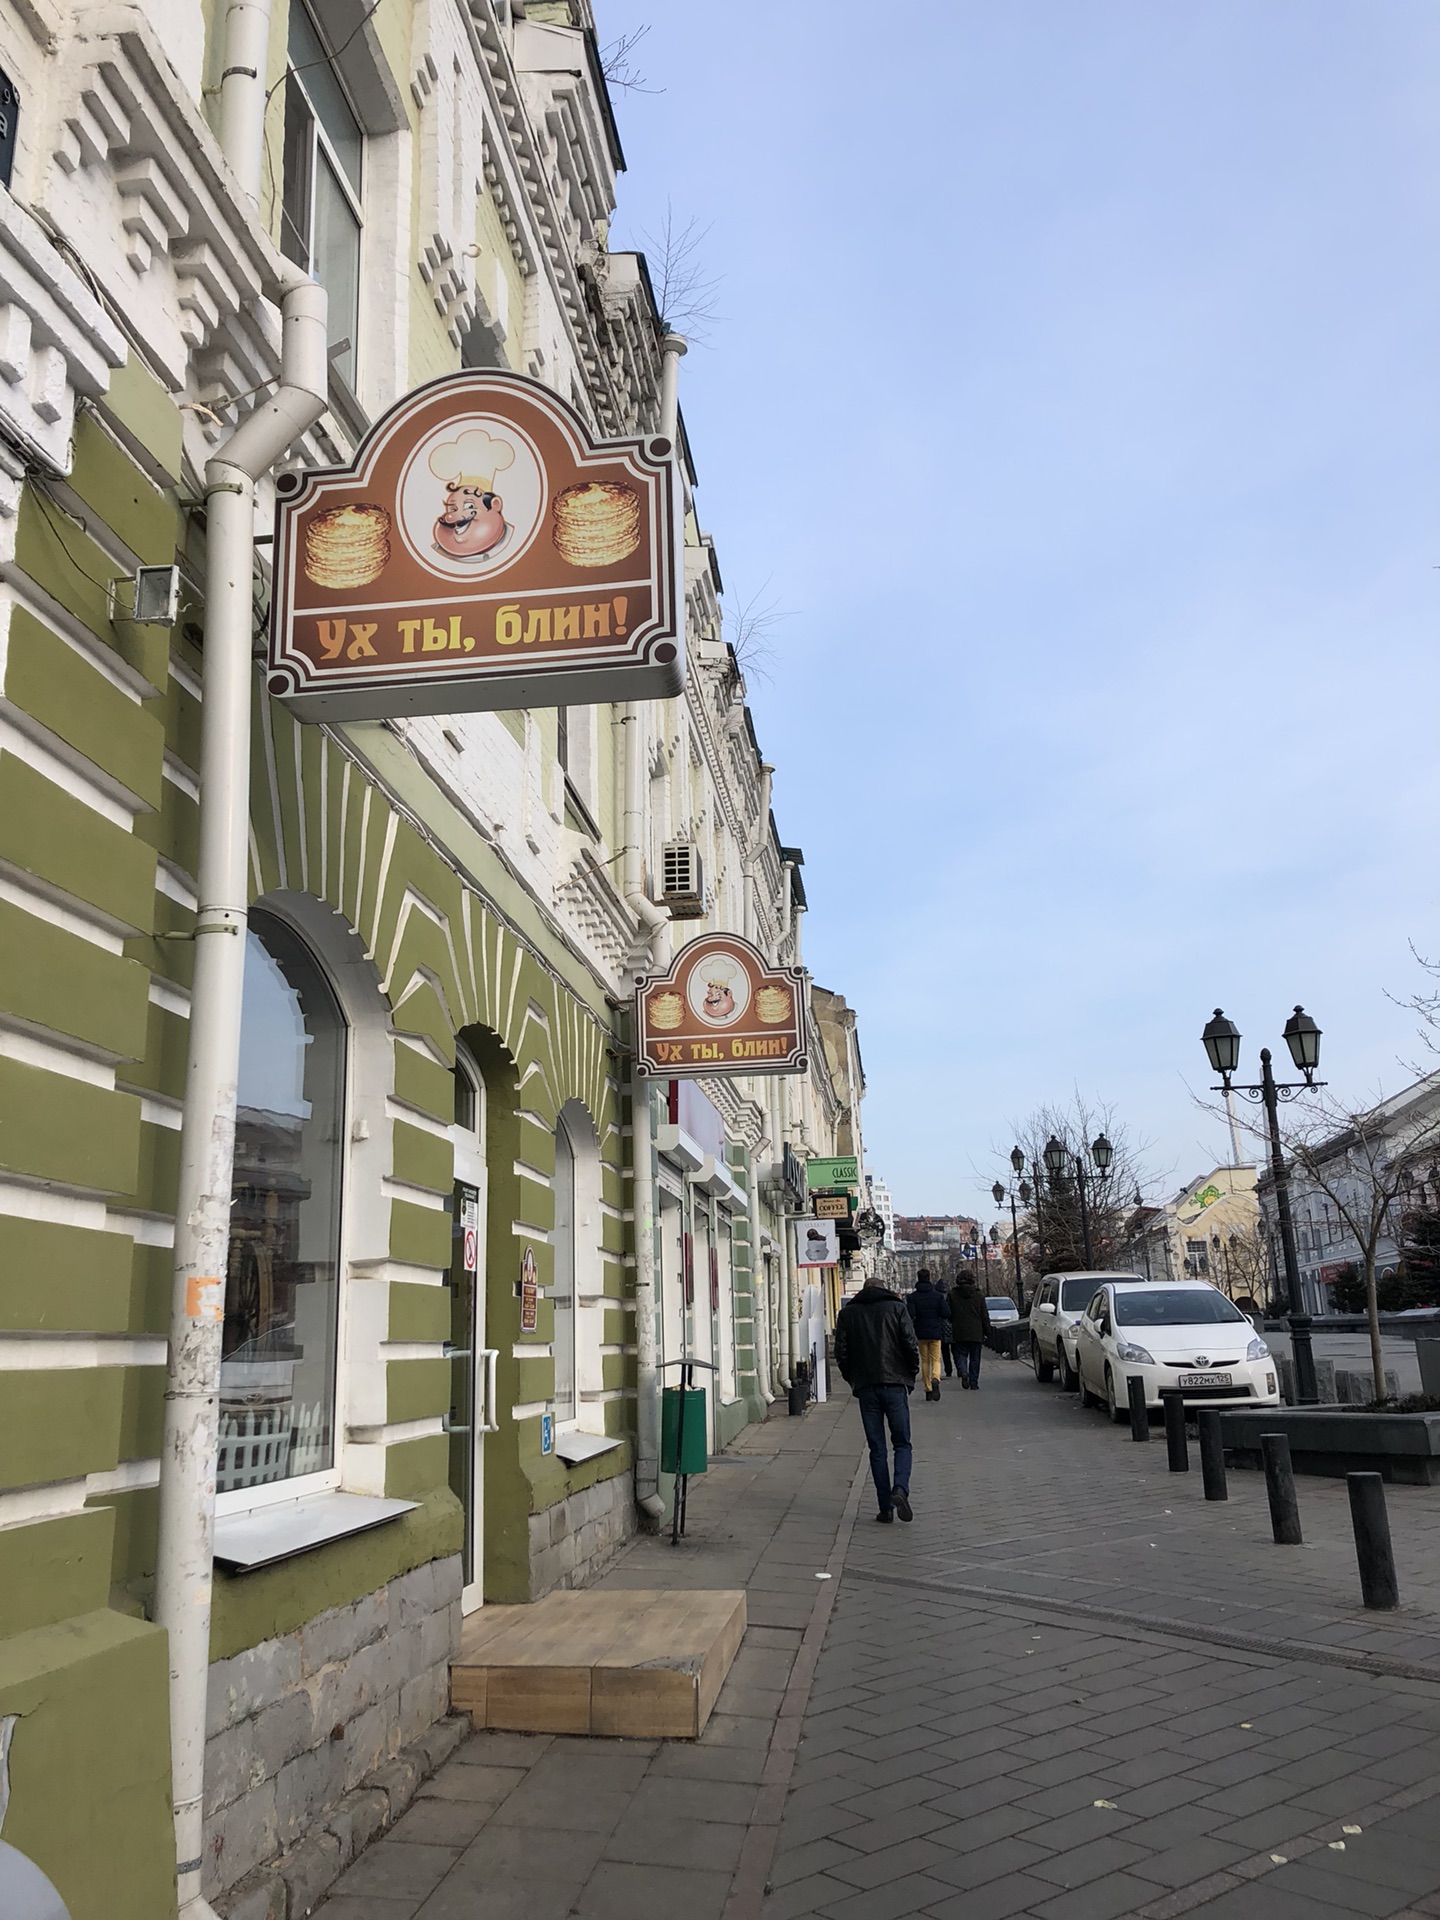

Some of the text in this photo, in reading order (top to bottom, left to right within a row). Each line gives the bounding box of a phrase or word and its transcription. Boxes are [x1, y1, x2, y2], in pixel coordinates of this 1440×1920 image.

[316, 596, 628, 660] Ух ты, блин!
[656, 1037, 787, 1061] Ух ты, блин!
[832, 1167, 857, 1178] CLASSIC
[818, 1203, 845, 1211] COFFEE
